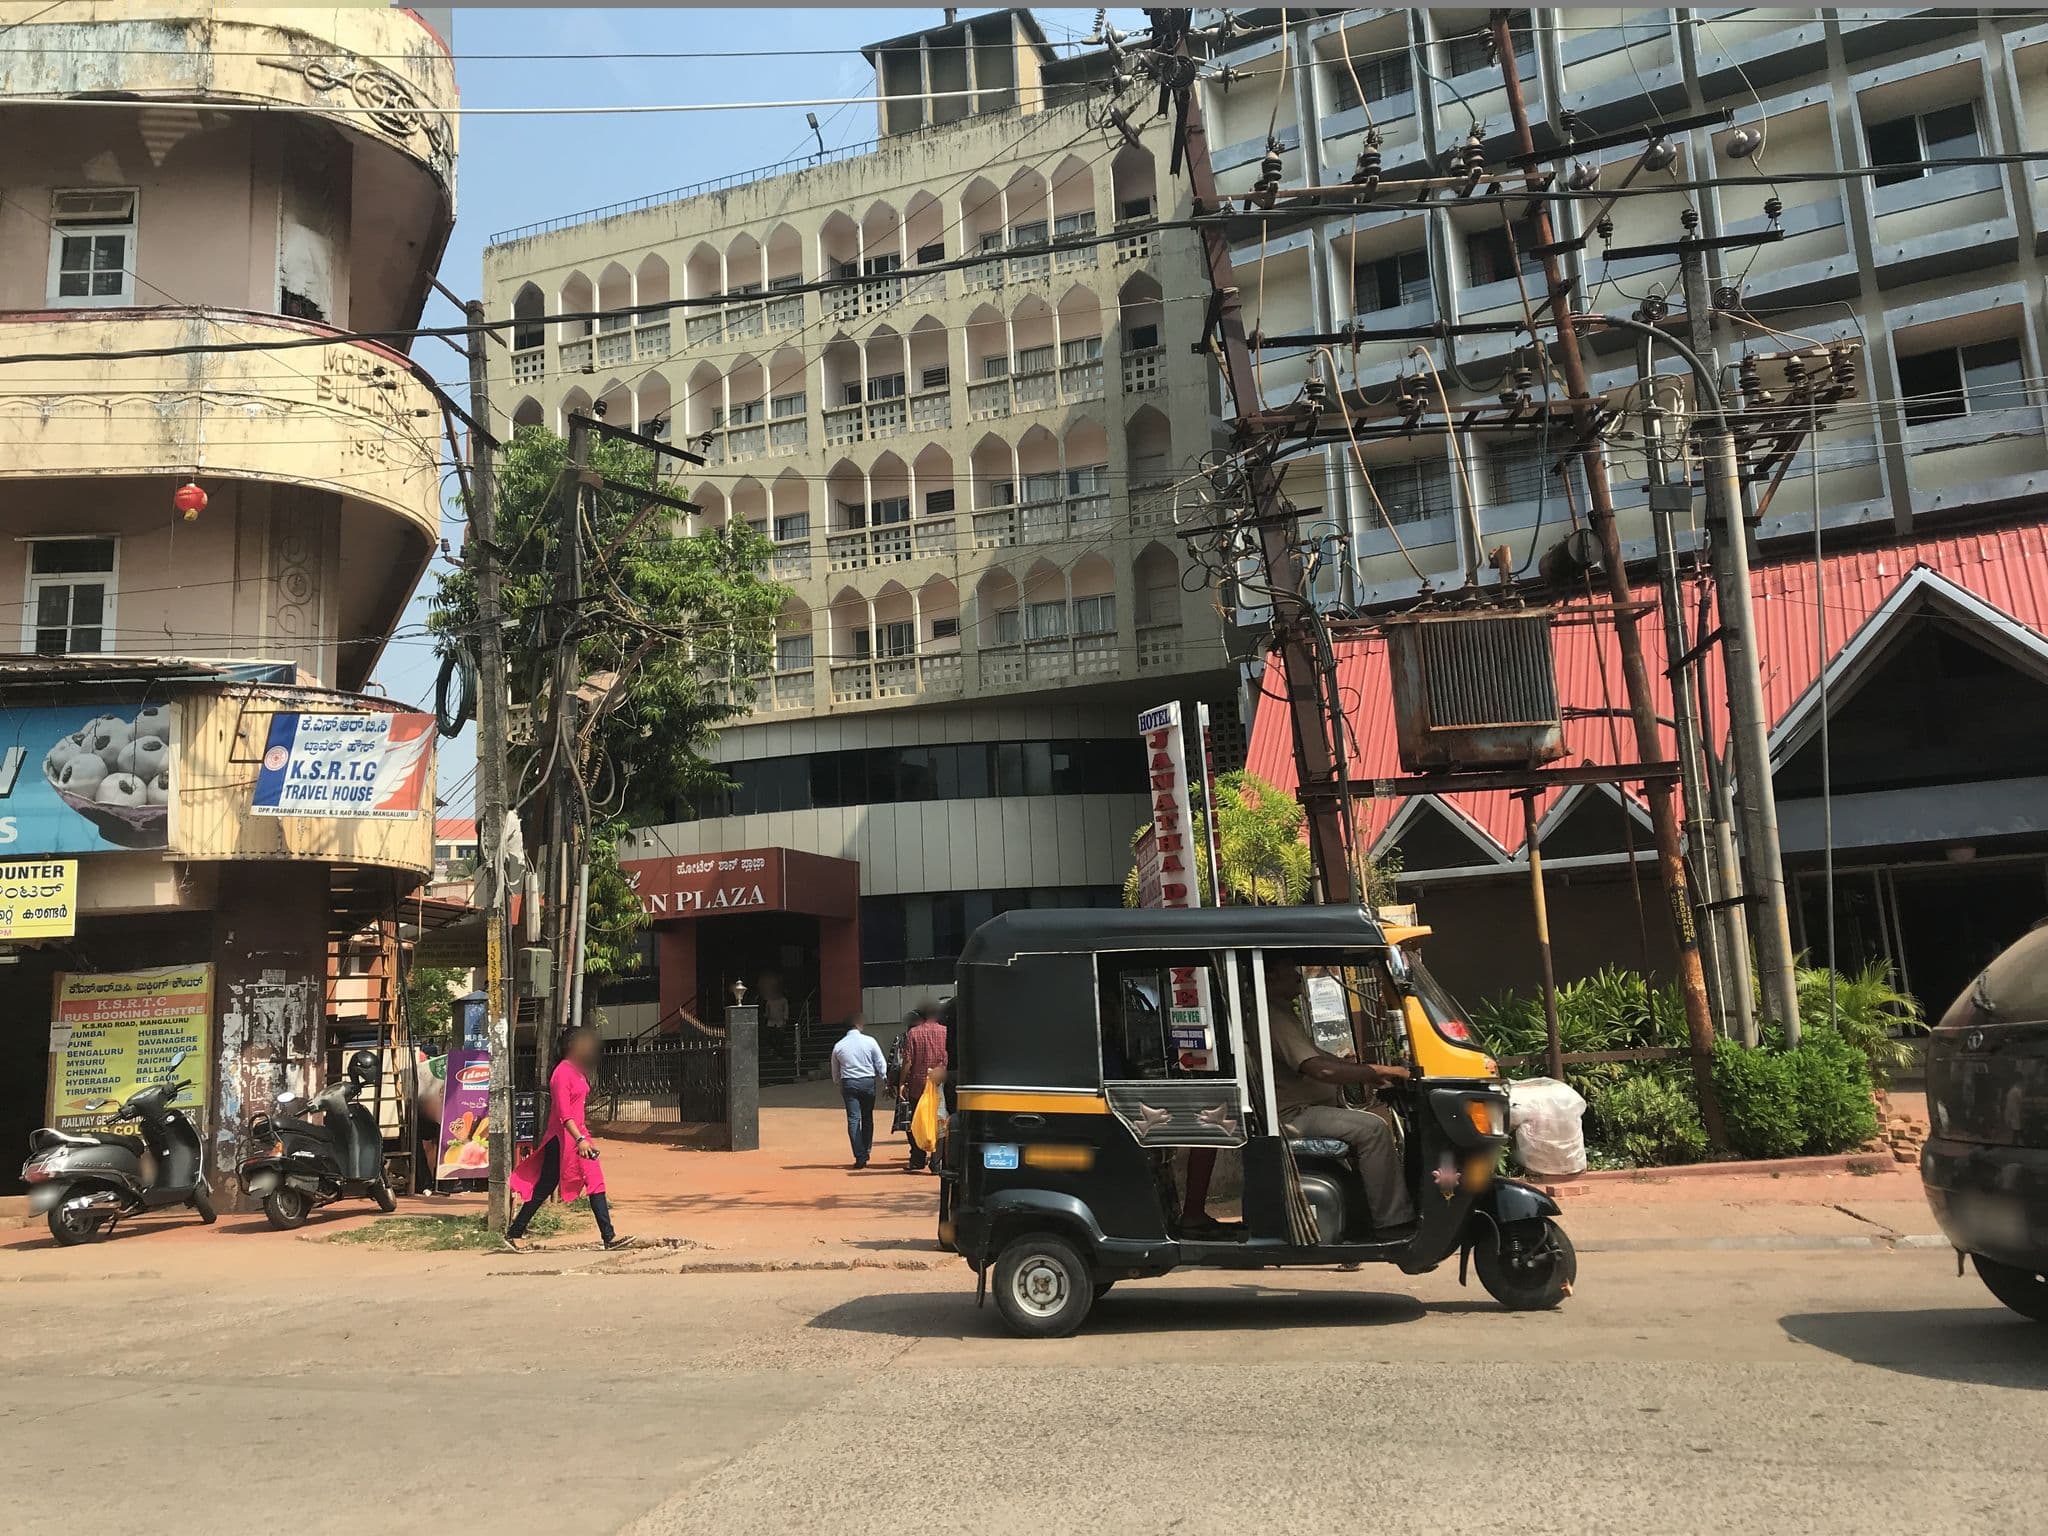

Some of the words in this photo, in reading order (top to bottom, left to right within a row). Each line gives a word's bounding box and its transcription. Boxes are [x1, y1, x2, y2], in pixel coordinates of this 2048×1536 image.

[1139, 709, 1171, 732] HOTEL
[290, 760, 377, 781] K.S.R.T.C
[285, 784, 328, 801] TRAVEL
[332, 786, 373, 802] HOUSE
[372, 810, 409, 818] MANGALURU
[0, 865, 64, 880] UNTER
[675, 885, 766, 911] PLAZA
[97, 997, 168, 1010] K.S.R.T.C
[64, 1013, 90, 1022] BUS
[93, 1009, 150, 1020] BOOKING
[154, 1006, 205, 1016] CENTRE
[139, 1018, 190, 1027] MANGALURU
[138, 1028, 184, 1037] HUBBALLI
[138, 1036, 198, 1046] DAVANAGERE
[66, 1048, 124, 1058] BENGALURU
[137, 1045, 198, 1056] SHIVAMOGGA
[66, 1058, 105, 1067] MYSURU
[66, 1068, 107, 1077] CHENNAI
[65, 1077, 121, 1086] HYDERABAD
[136, 1074, 180, 1084] BELGAUM
[65, 1086, 112, 1096] TIRUPATHI
[61, 1115, 95, 1128] RAILWAY
